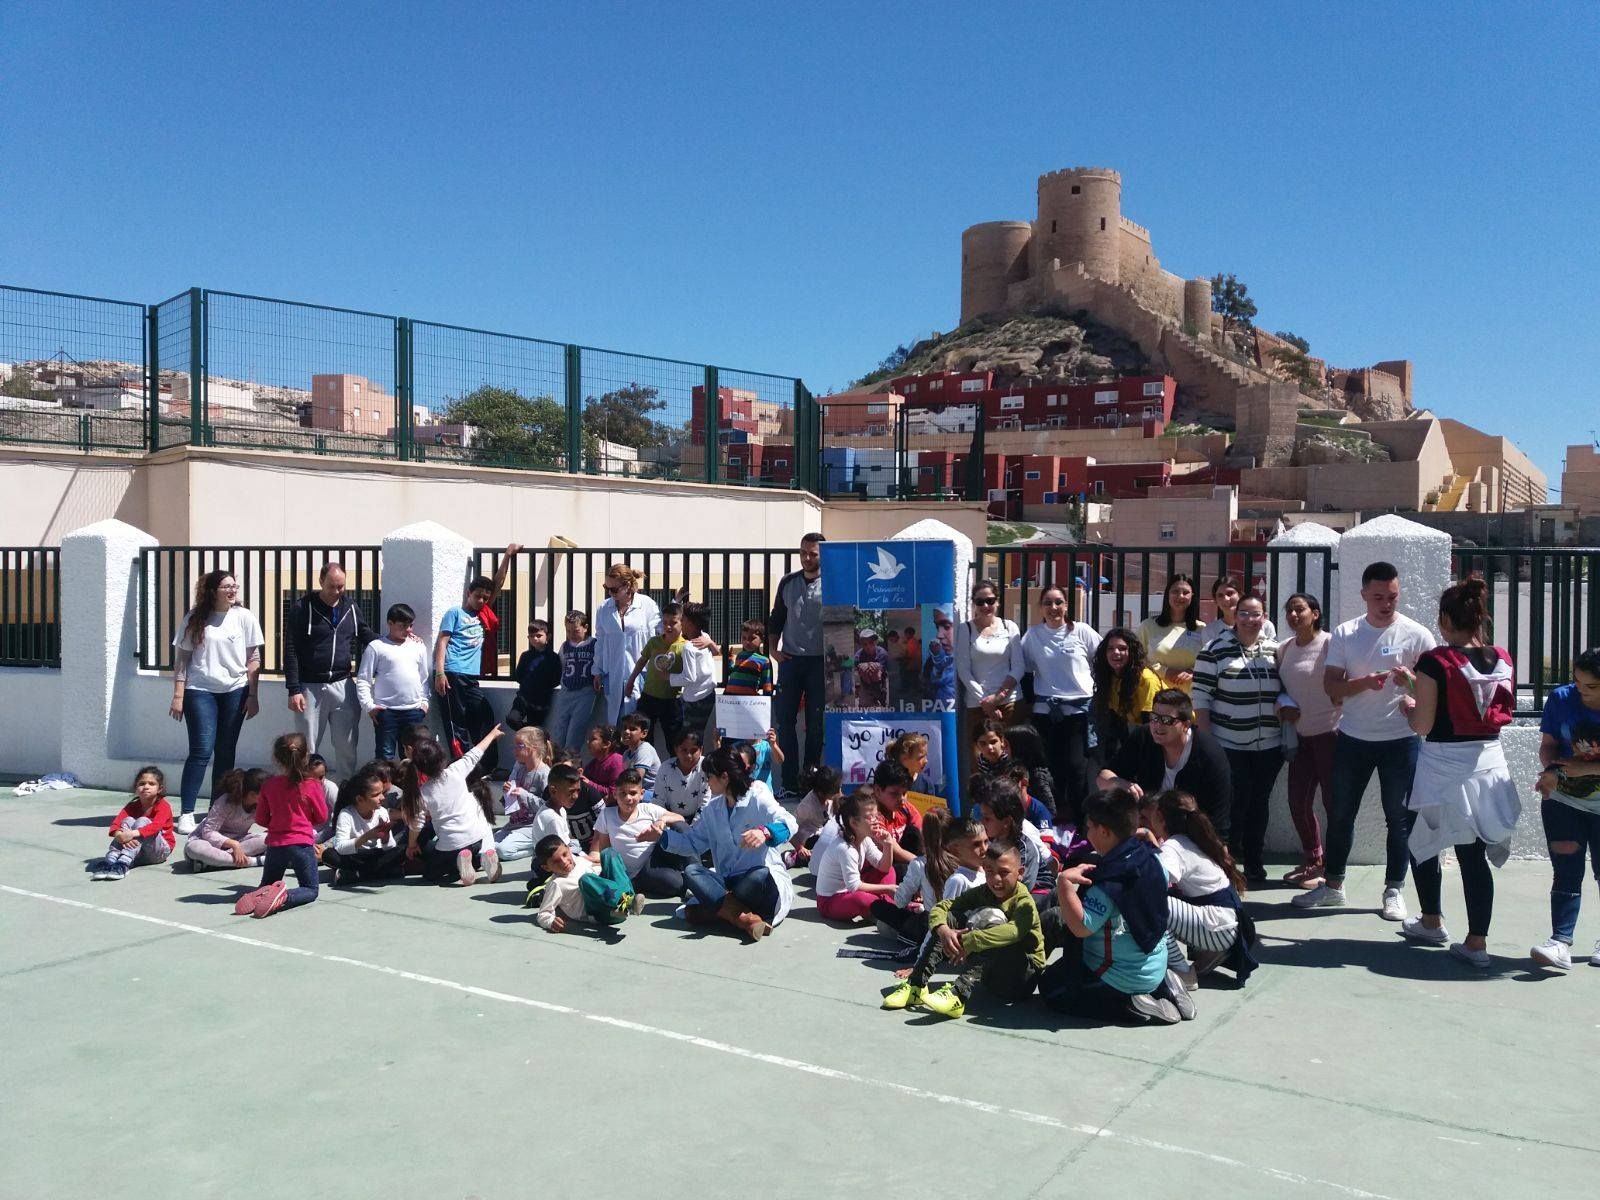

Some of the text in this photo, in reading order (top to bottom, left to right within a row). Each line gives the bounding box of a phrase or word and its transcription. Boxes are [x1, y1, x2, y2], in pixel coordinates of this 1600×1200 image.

[565, 658, 591, 678] 57
[899, 698, 915, 713] la
[921, 698, 956, 713] PAZ
[848, 727, 930, 750] yo jue
